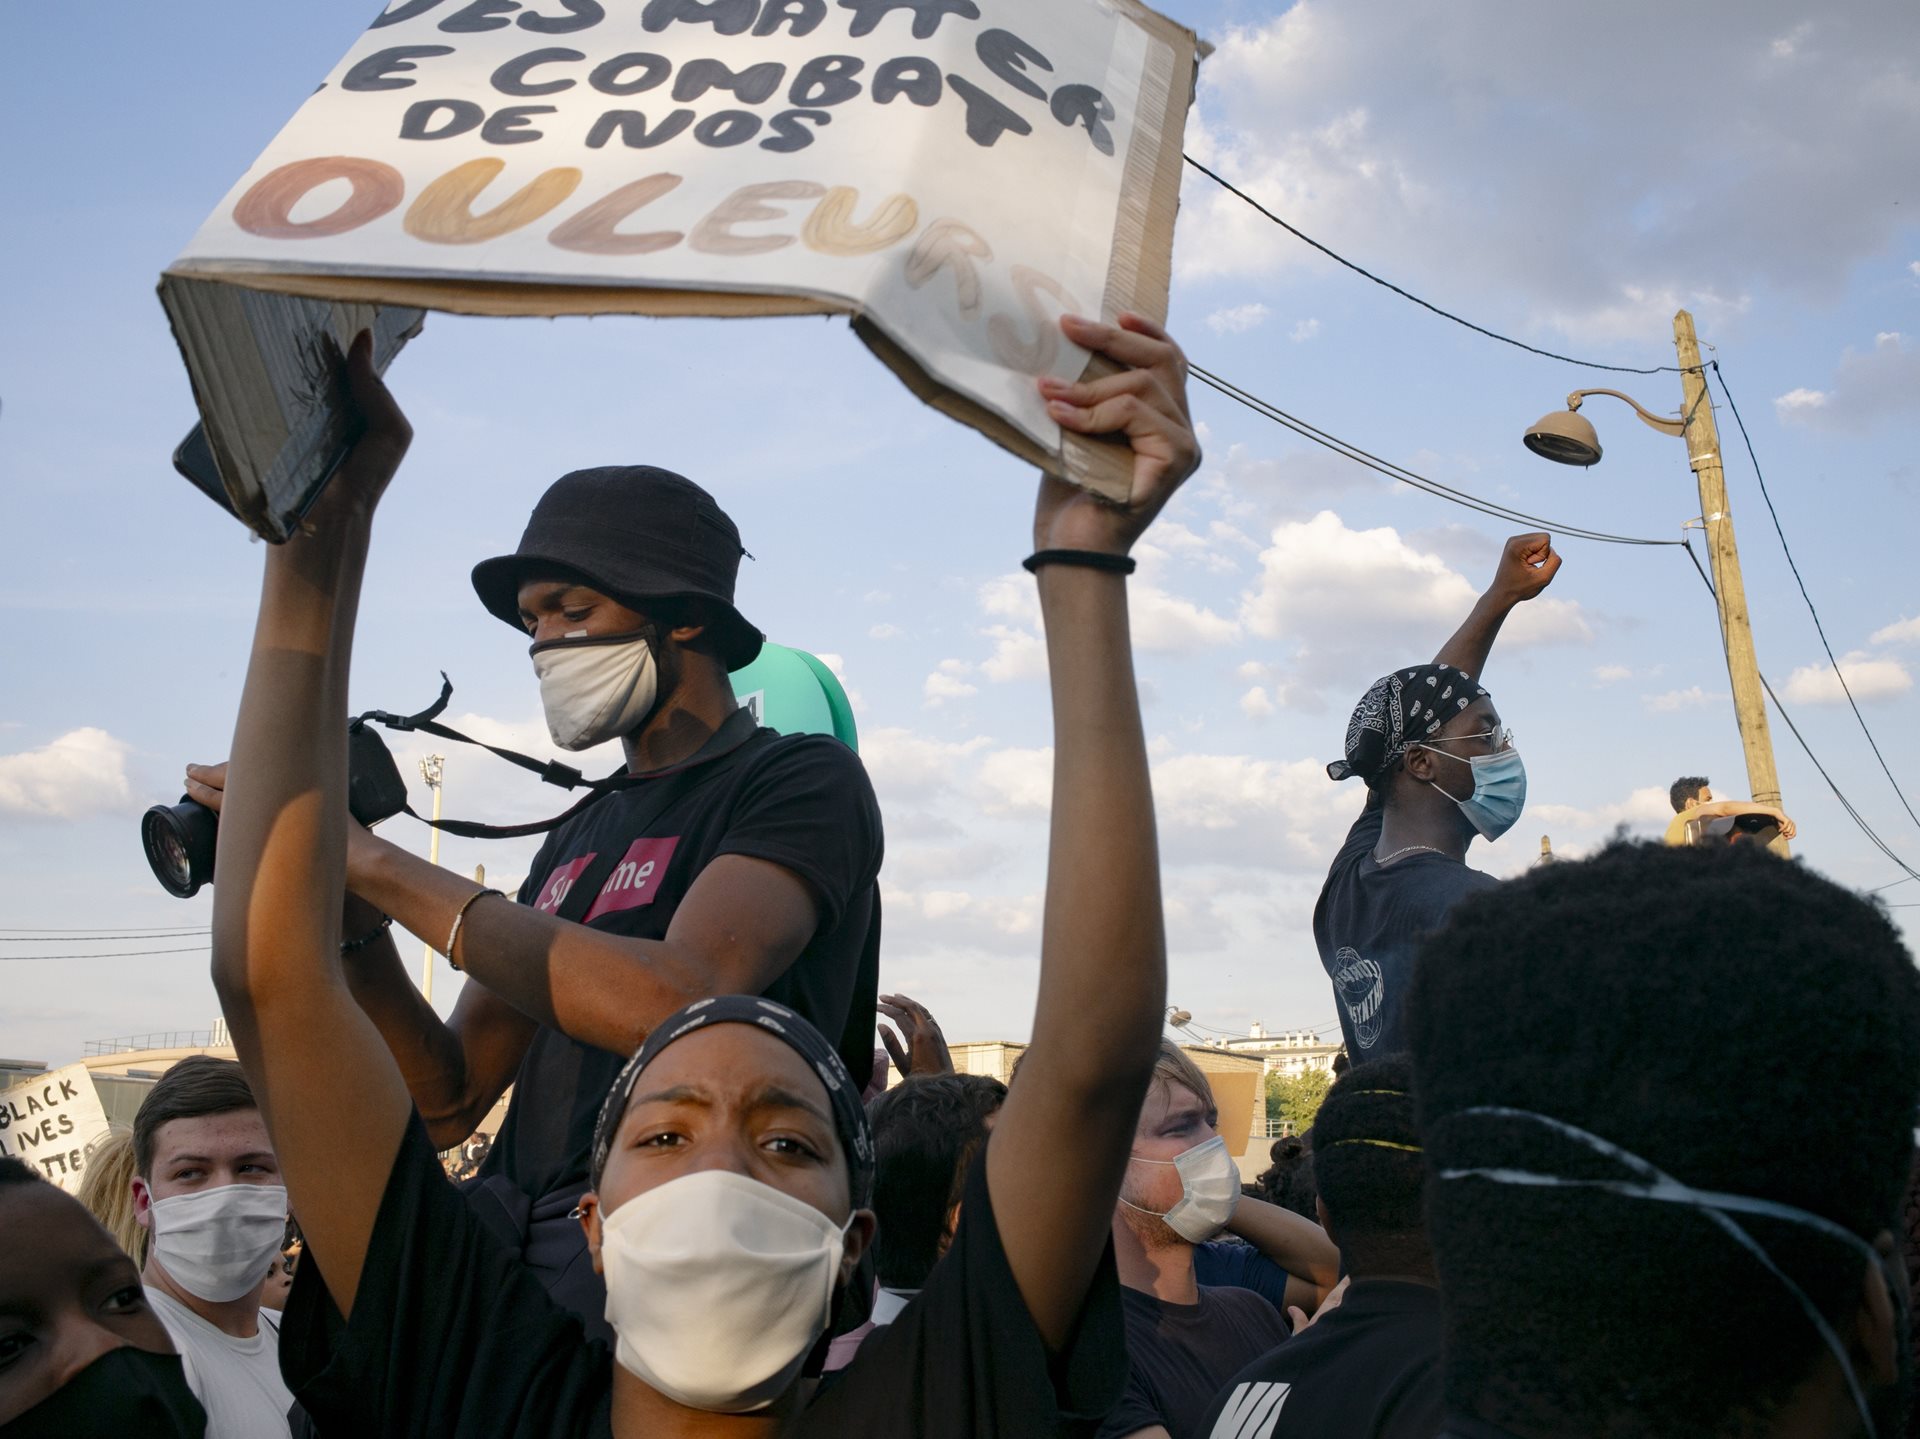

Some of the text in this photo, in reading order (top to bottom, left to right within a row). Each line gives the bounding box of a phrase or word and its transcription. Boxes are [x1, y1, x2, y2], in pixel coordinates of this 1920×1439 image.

[312, 44, 1034, 147] E COMBAT
[398, 98, 832, 153] DE NOS
[640, 0, 1116, 157] MATTER
